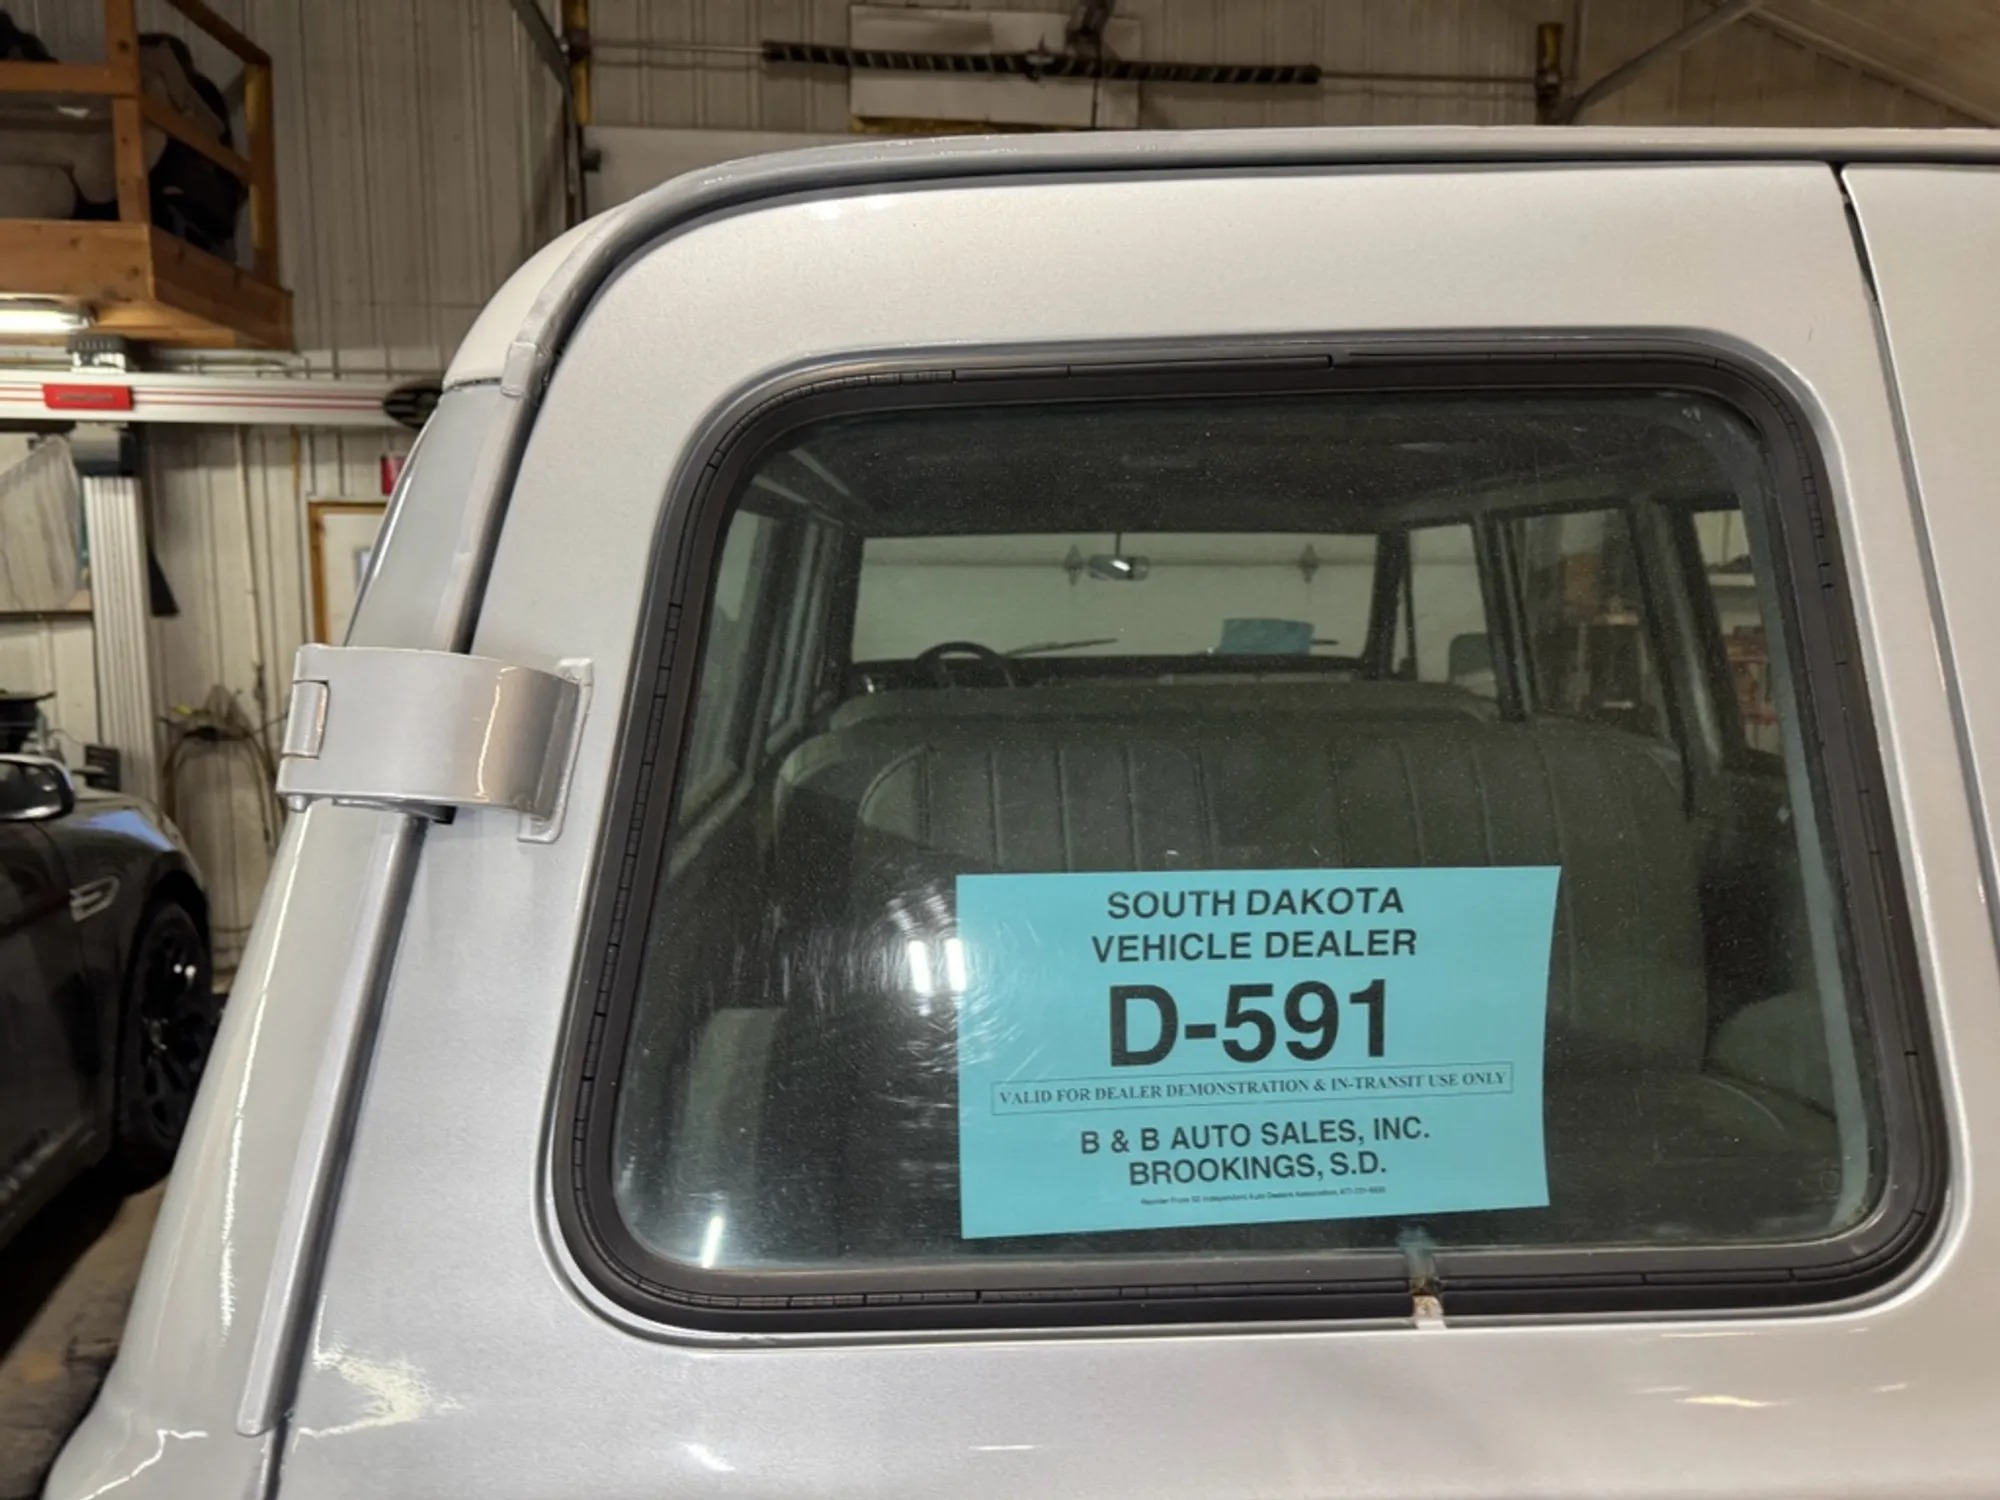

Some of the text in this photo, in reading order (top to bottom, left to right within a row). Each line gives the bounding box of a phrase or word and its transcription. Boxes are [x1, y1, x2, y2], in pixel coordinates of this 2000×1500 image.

[1107, 886, 1405, 920] SOUTH DAKOTA
[1091, 928, 1417, 963] VEHICLE DEALER
[1109, 978, 1387, 1067] D-591
[1000, 1071, 1507, 1105] VALID FOR DEALER DEMONSTRATION & IN-TRANSIT USE ONLY
[1080, 1115, 1430, 1154] B & B AUTO SALES, INC.
[1129, 1150, 1387, 1186] BROOKINGS, S.D.
